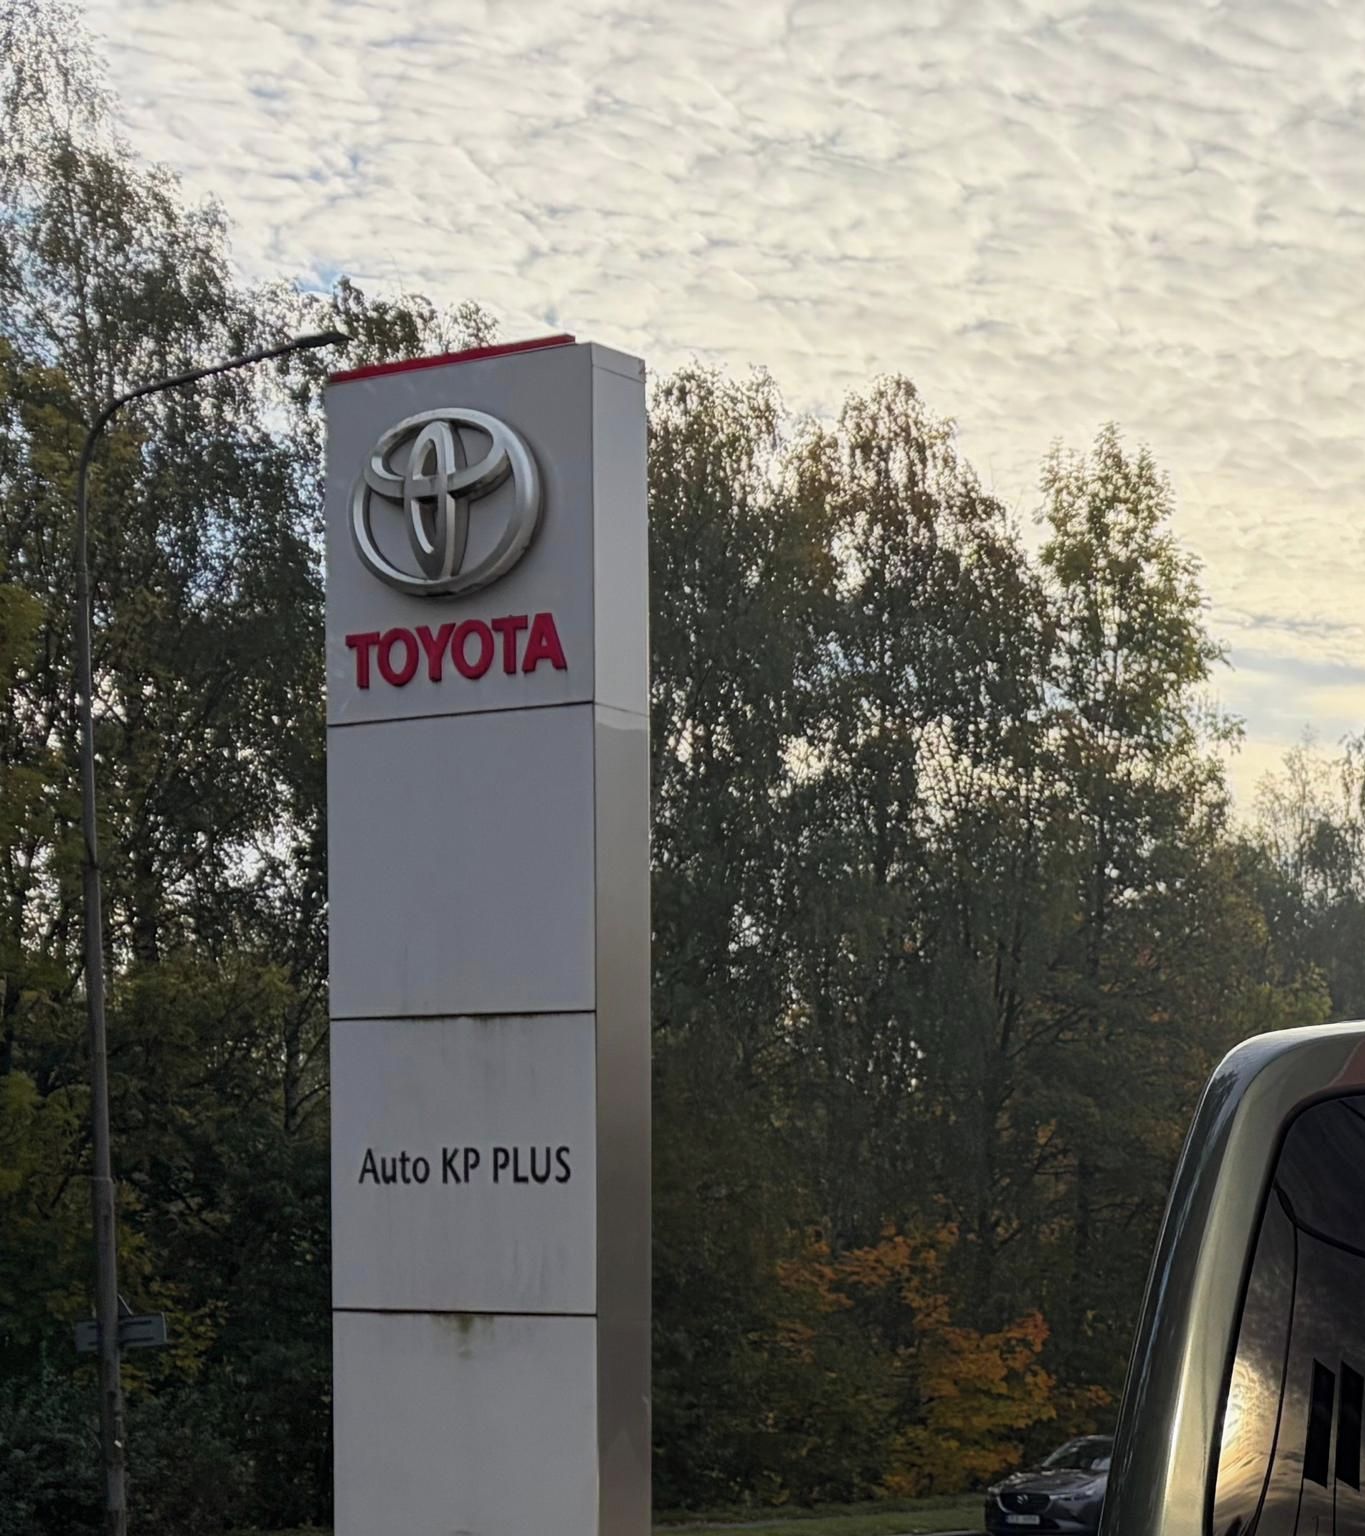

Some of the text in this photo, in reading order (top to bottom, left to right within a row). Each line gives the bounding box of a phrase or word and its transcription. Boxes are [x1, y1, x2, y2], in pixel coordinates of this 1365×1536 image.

[345, 612, 567, 689] TOYOTA
[358, 1146, 571, 1184] Auto KP PLUS
